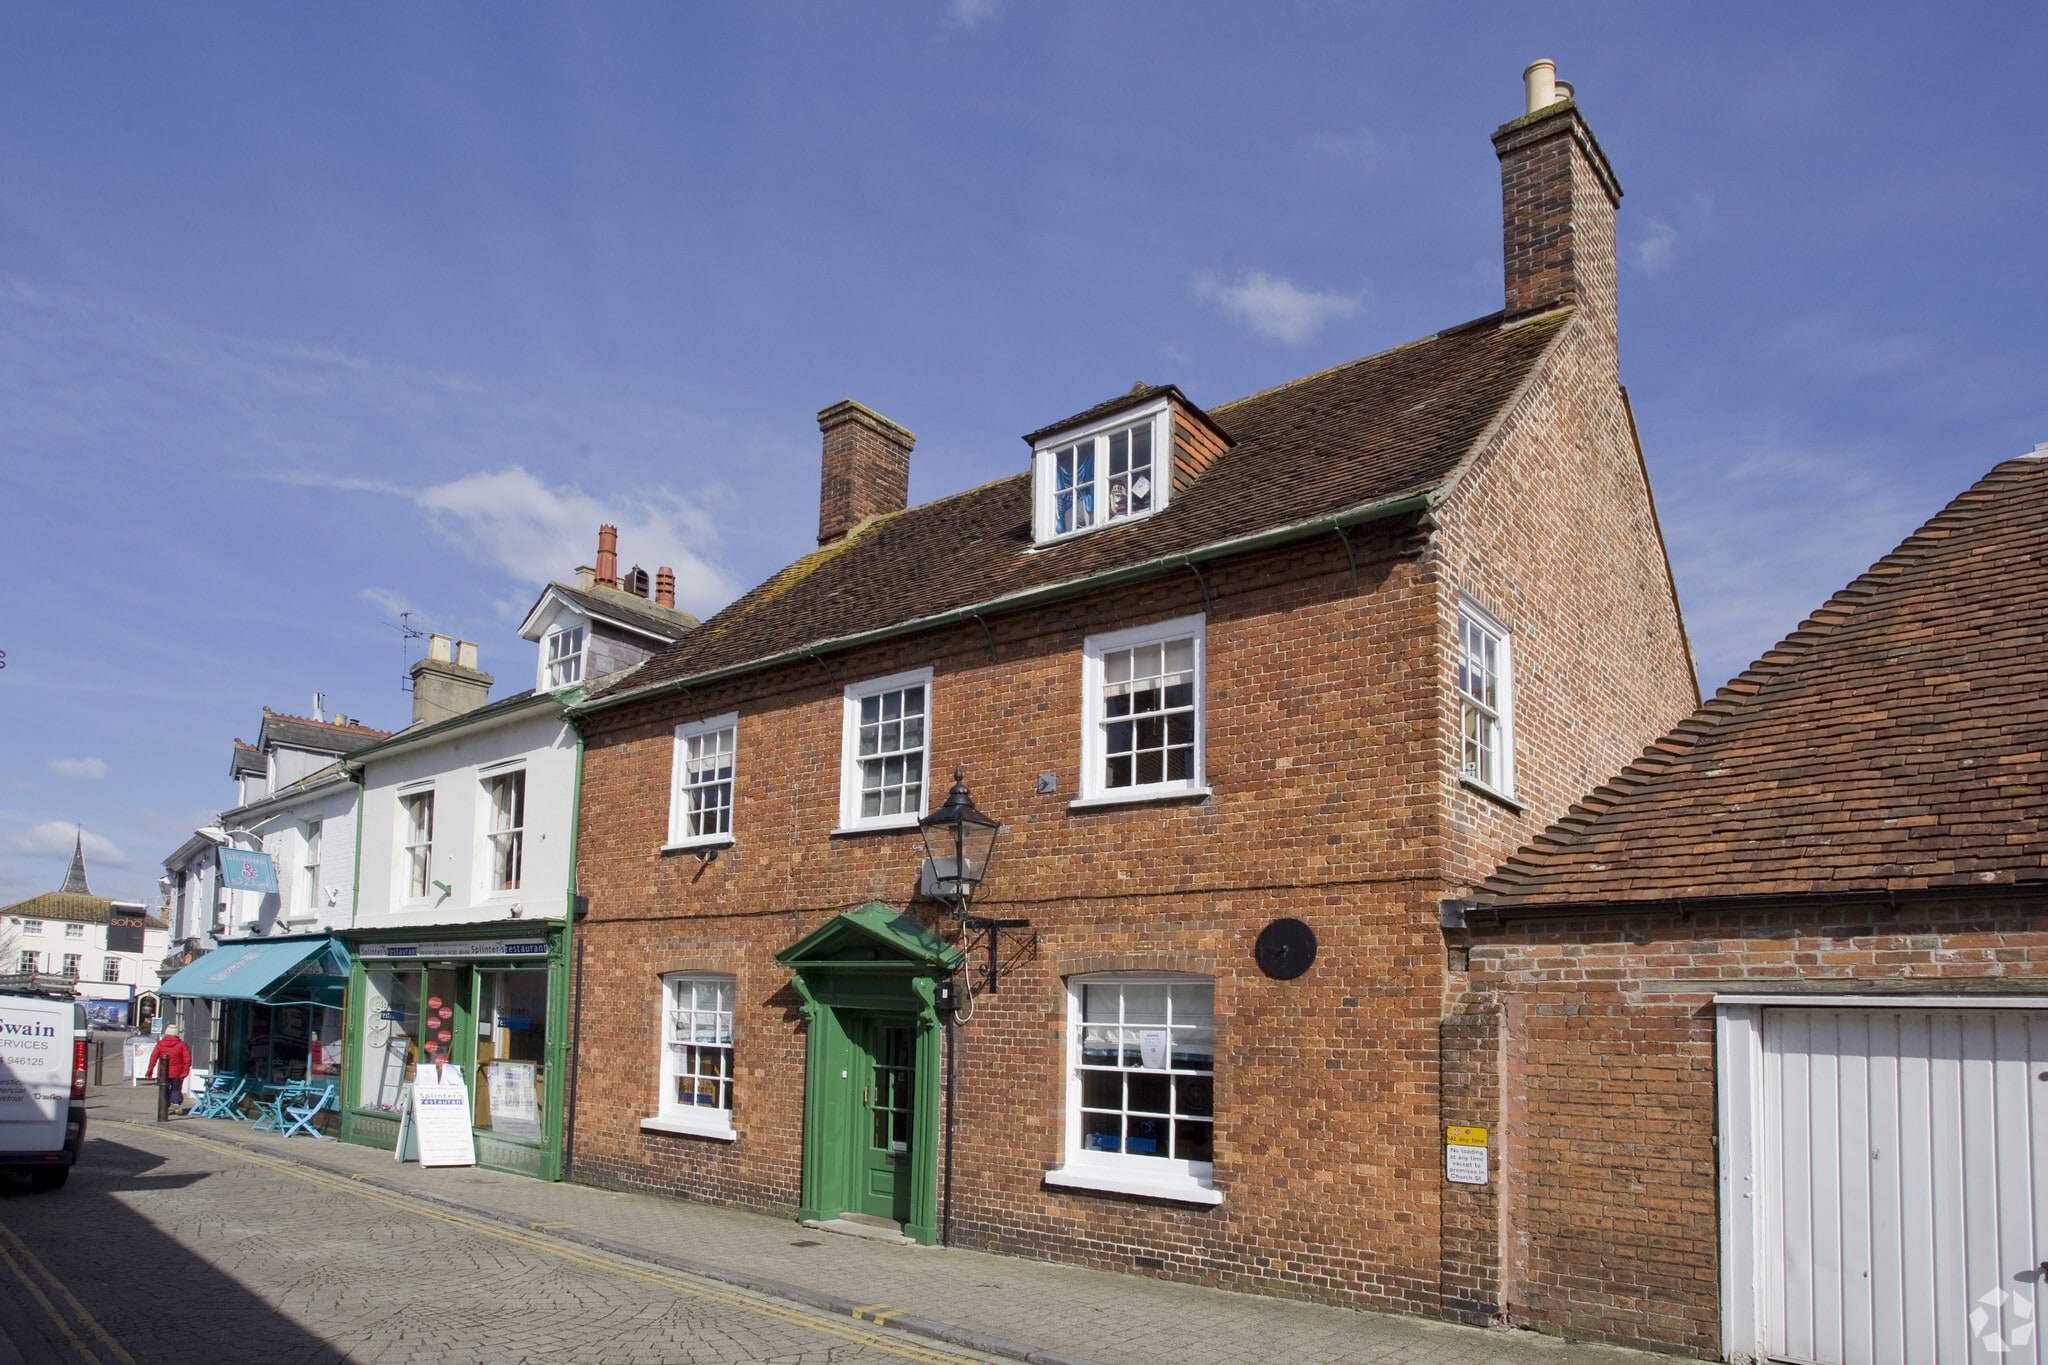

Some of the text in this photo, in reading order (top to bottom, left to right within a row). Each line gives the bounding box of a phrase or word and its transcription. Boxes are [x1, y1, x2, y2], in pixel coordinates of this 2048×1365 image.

[111, 917, 143, 928] soho
[471, 944, 505, 954] Splinter's
[506, 944, 547, 953] restaurant
[8, 1056, 44, 1066] 946125
[1461, 1148, 1483, 1156] loading
